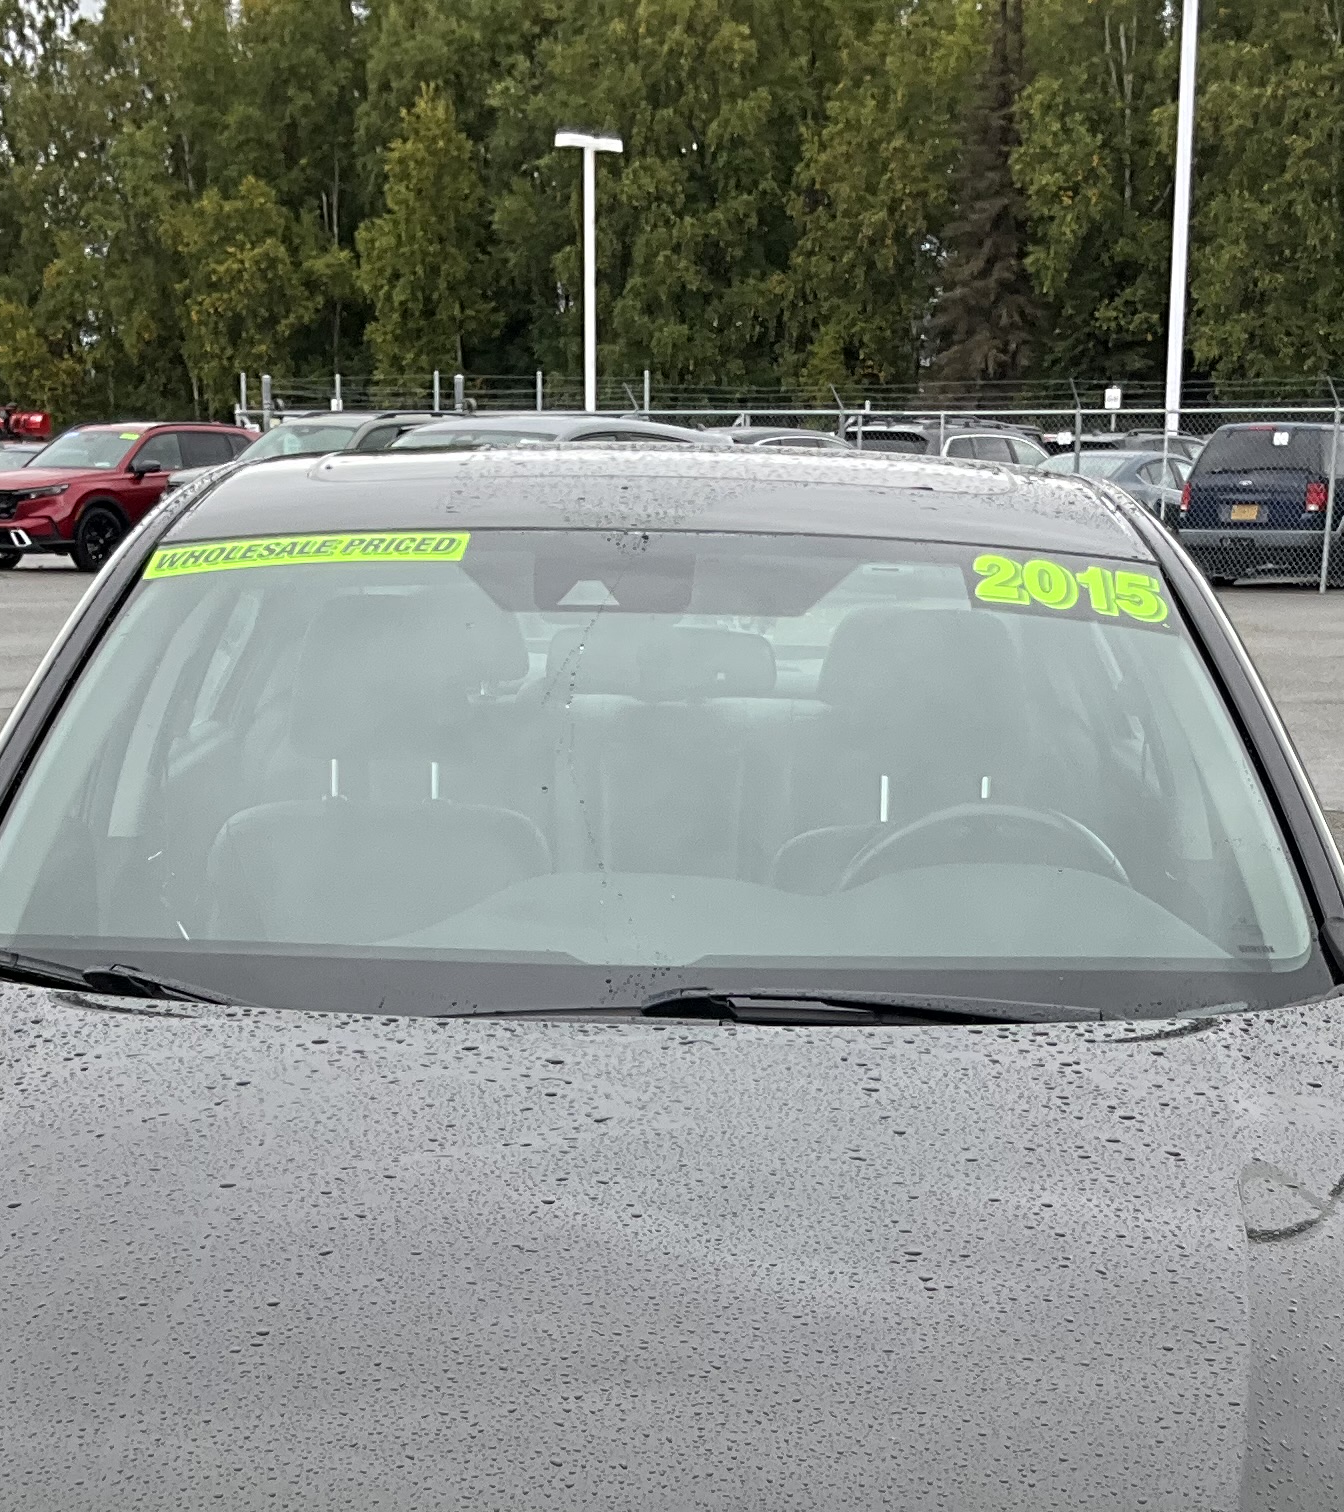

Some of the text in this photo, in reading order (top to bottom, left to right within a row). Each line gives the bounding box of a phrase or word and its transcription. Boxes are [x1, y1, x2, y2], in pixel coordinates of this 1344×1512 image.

[156, 536, 464, 572] WHOLESALE PRICED
[973, 554, 1168, 622] 2015
